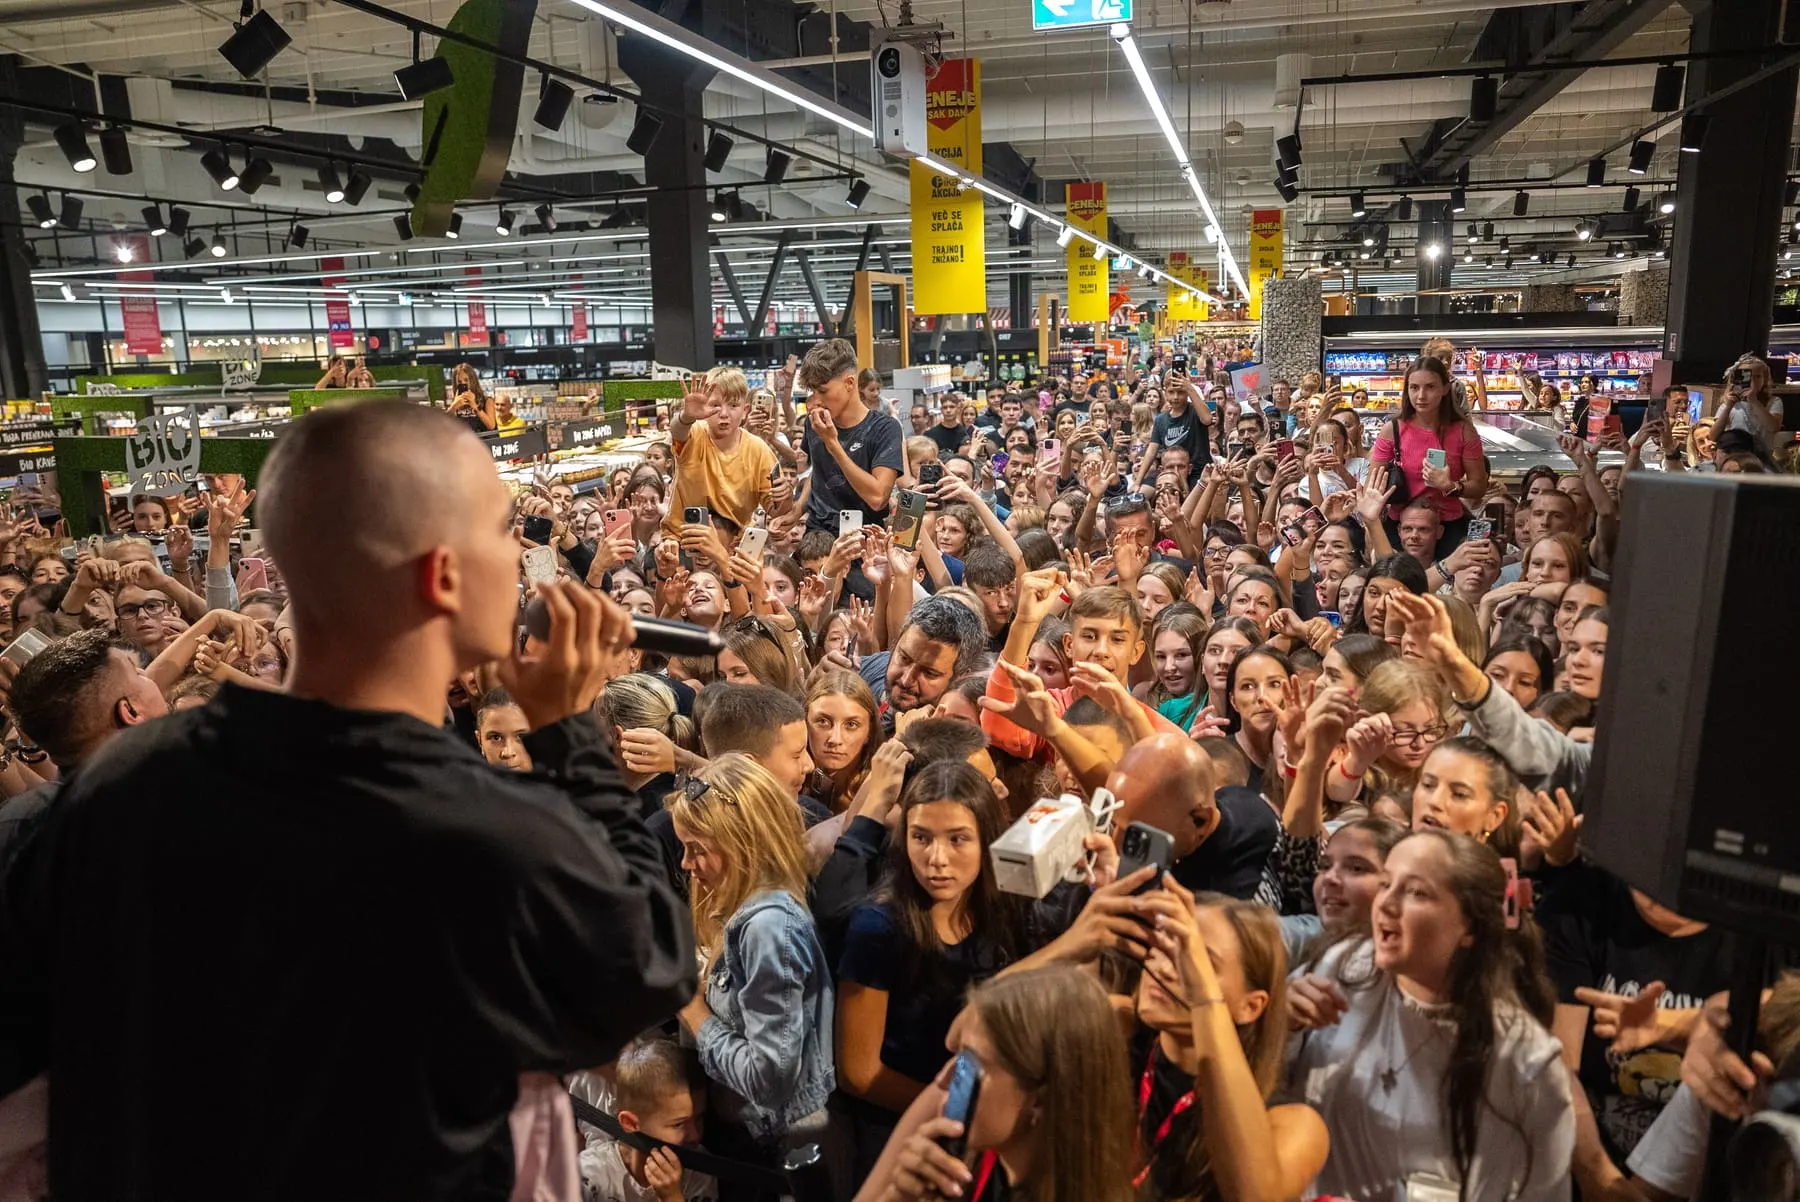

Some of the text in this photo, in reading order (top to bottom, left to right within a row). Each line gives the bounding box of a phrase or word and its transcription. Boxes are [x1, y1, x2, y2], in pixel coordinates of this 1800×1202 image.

[926, 90, 975, 107] ENEJE
[928, 109, 946, 119] SAK
[929, 147, 963, 159] KCIJA
[932, 208, 962, 221] VEČ SE
[931, 220, 963, 232] SPLAČA
[932, 245, 959, 254] TRAJNO
[932, 254, 959, 264] ZNIŽANO
[230, 372, 257, 385] ZONE
[142, 465, 193, 491] ZONE
